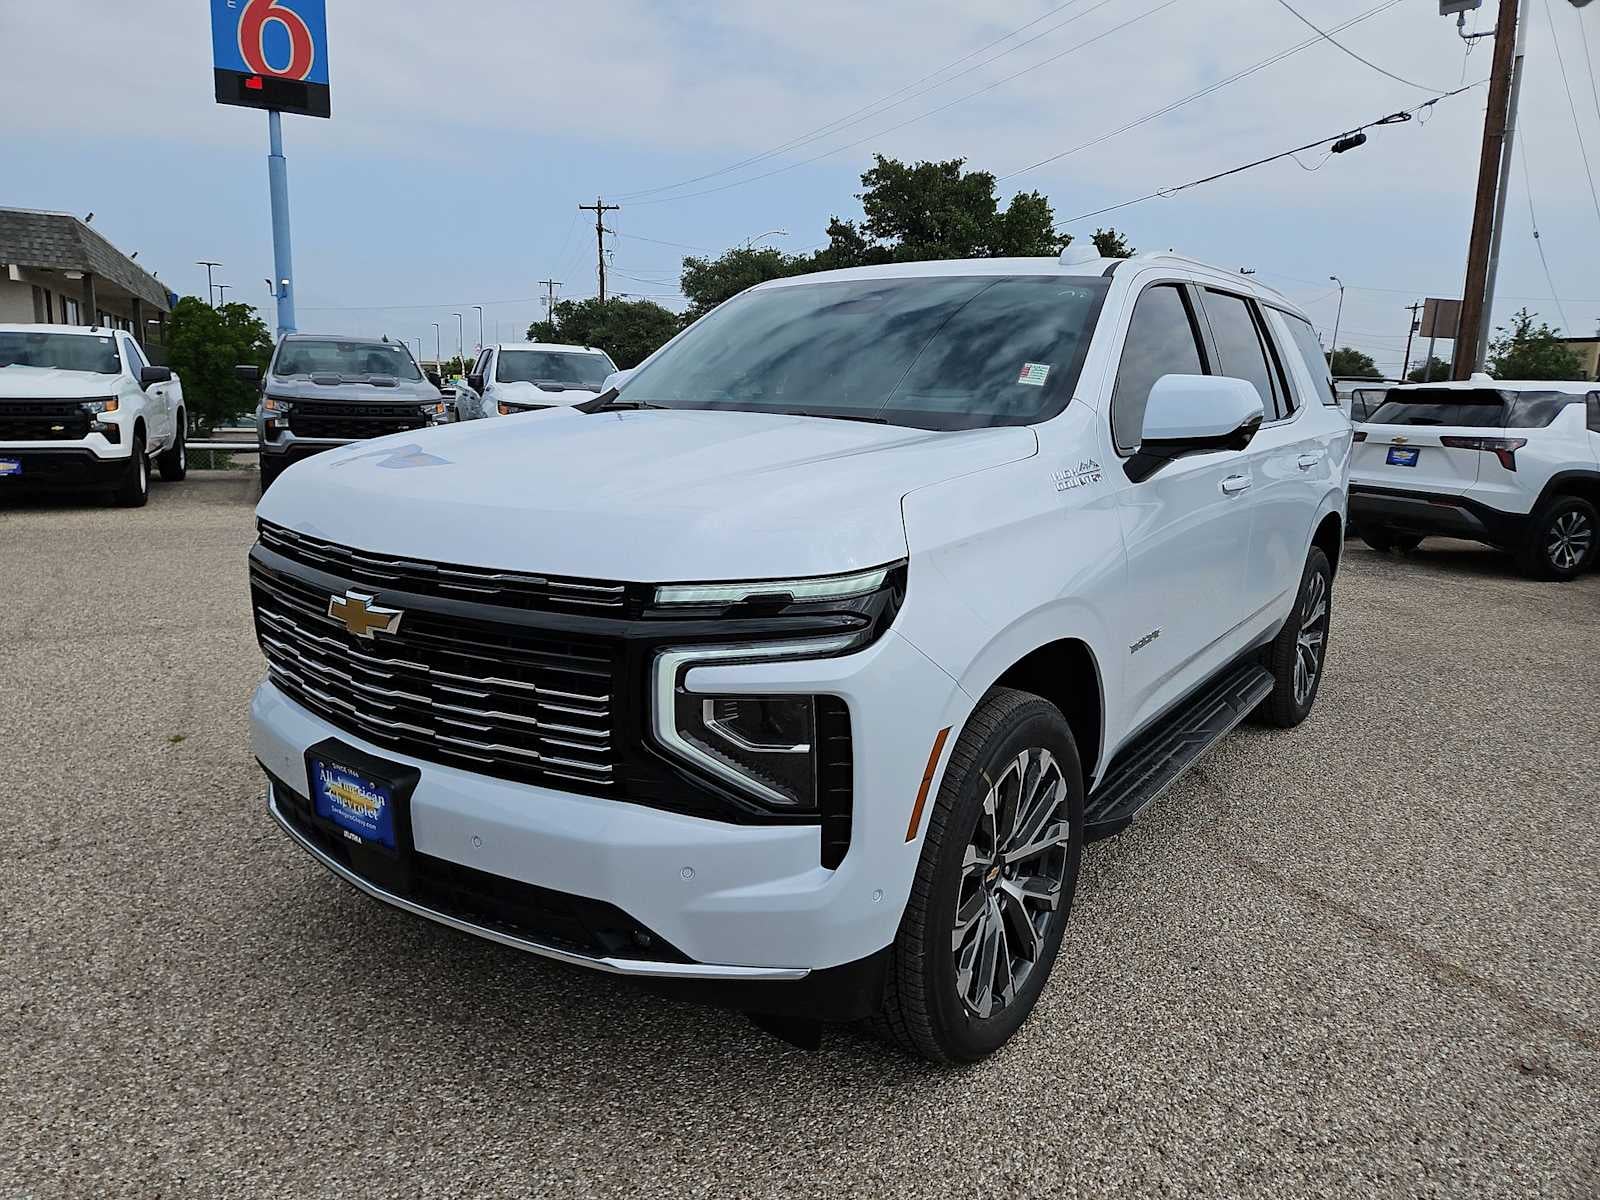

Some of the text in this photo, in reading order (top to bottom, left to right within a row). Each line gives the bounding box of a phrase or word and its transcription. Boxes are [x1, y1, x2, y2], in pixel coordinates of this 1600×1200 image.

[237, 0, 314, 80] 6
[320, 769, 385, 806] All American
[328, 789, 378, 820] Chevrolet
